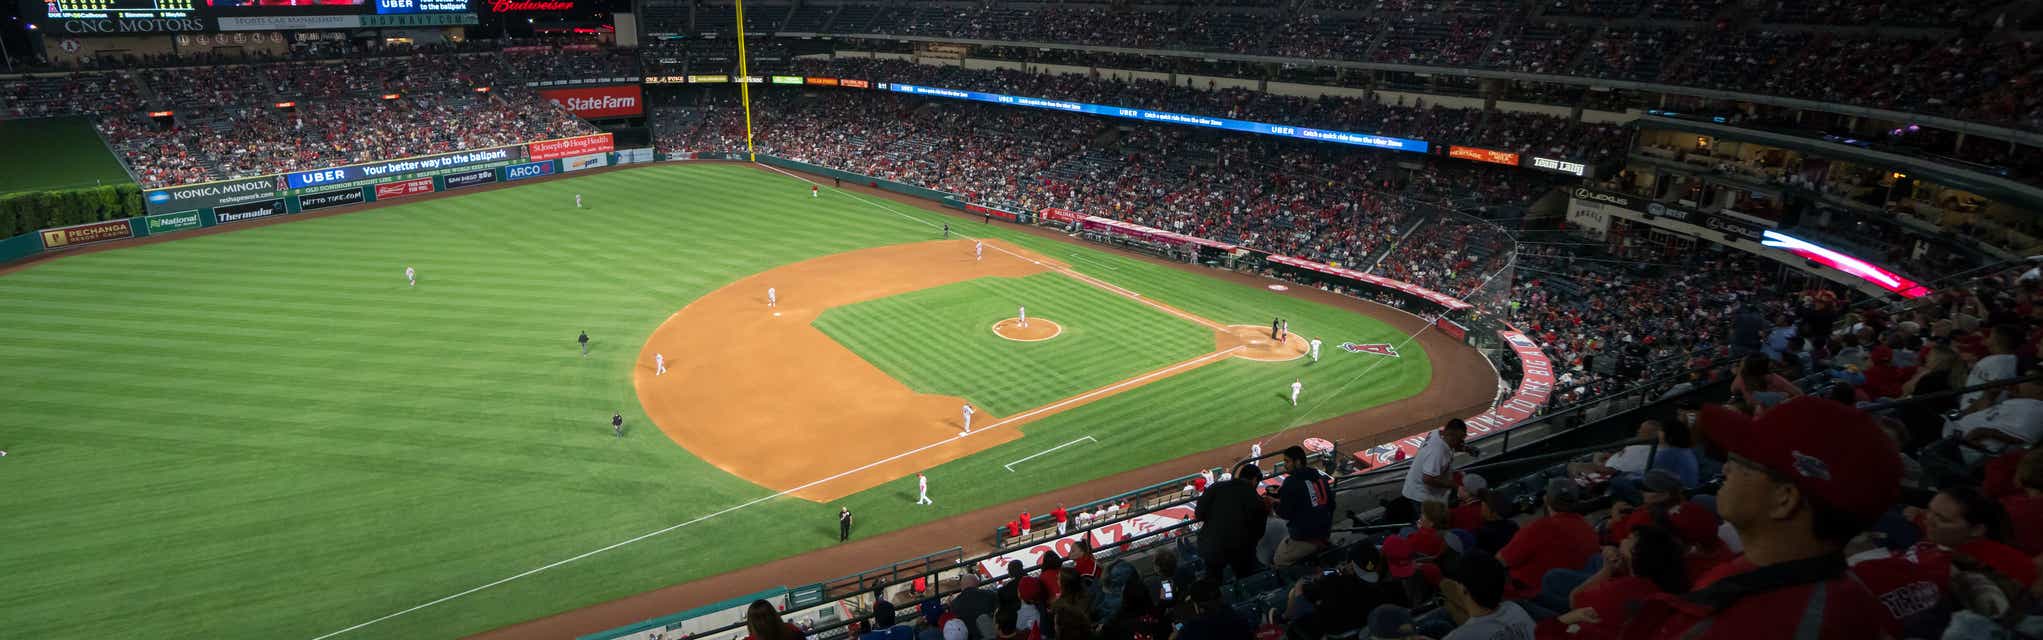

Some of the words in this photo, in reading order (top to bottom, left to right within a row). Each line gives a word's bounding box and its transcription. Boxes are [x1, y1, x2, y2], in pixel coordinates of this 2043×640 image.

[382, 0, 413, 8] UBER
[440, 3, 466, 11] ballpark
[488, 0, 574, 12] Budweiser
[65, 19, 114, 33] CNC
[119, 18, 204, 32] MOTORS
[567, 96, 602, 111] State
[602, 95, 635, 109] Farm
[1119, 109, 1137, 117] UBER
[1271, 126, 1294, 135] UBER
[363, 165, 387, 176] Your
[389, 160, 419, 173] better
[421, 159, 440, 169] way
[441, 157, 452, 166] to
[453, 154, 469, 164] the
[471, 149, 507, 163] ballpark
[1534, 157, 1559, 170] Team
[302, 170, 346, 184] UBER
[510, 166, 540, 180] ARCO
[174, 188, 220, 200] KONICA
[222, 180, 272, 195] MINOLTA
[219, 191, 274, 204] reshapework.com
[302, 198, 326, 207] NITTO
[327, 191, 361, 202] TIRE.COM
[1589, 192, 1628, 205] LEXUS
[160, 214, 197, 225] National
[217, 207, 272, 222] Thermador
[69, 223, 127, 237] PECHANGA
[1526, 359, 1550, 377] BIG
[1520, 378, 1550, 398] THE
[1503, 398, 1537, 413] TO
